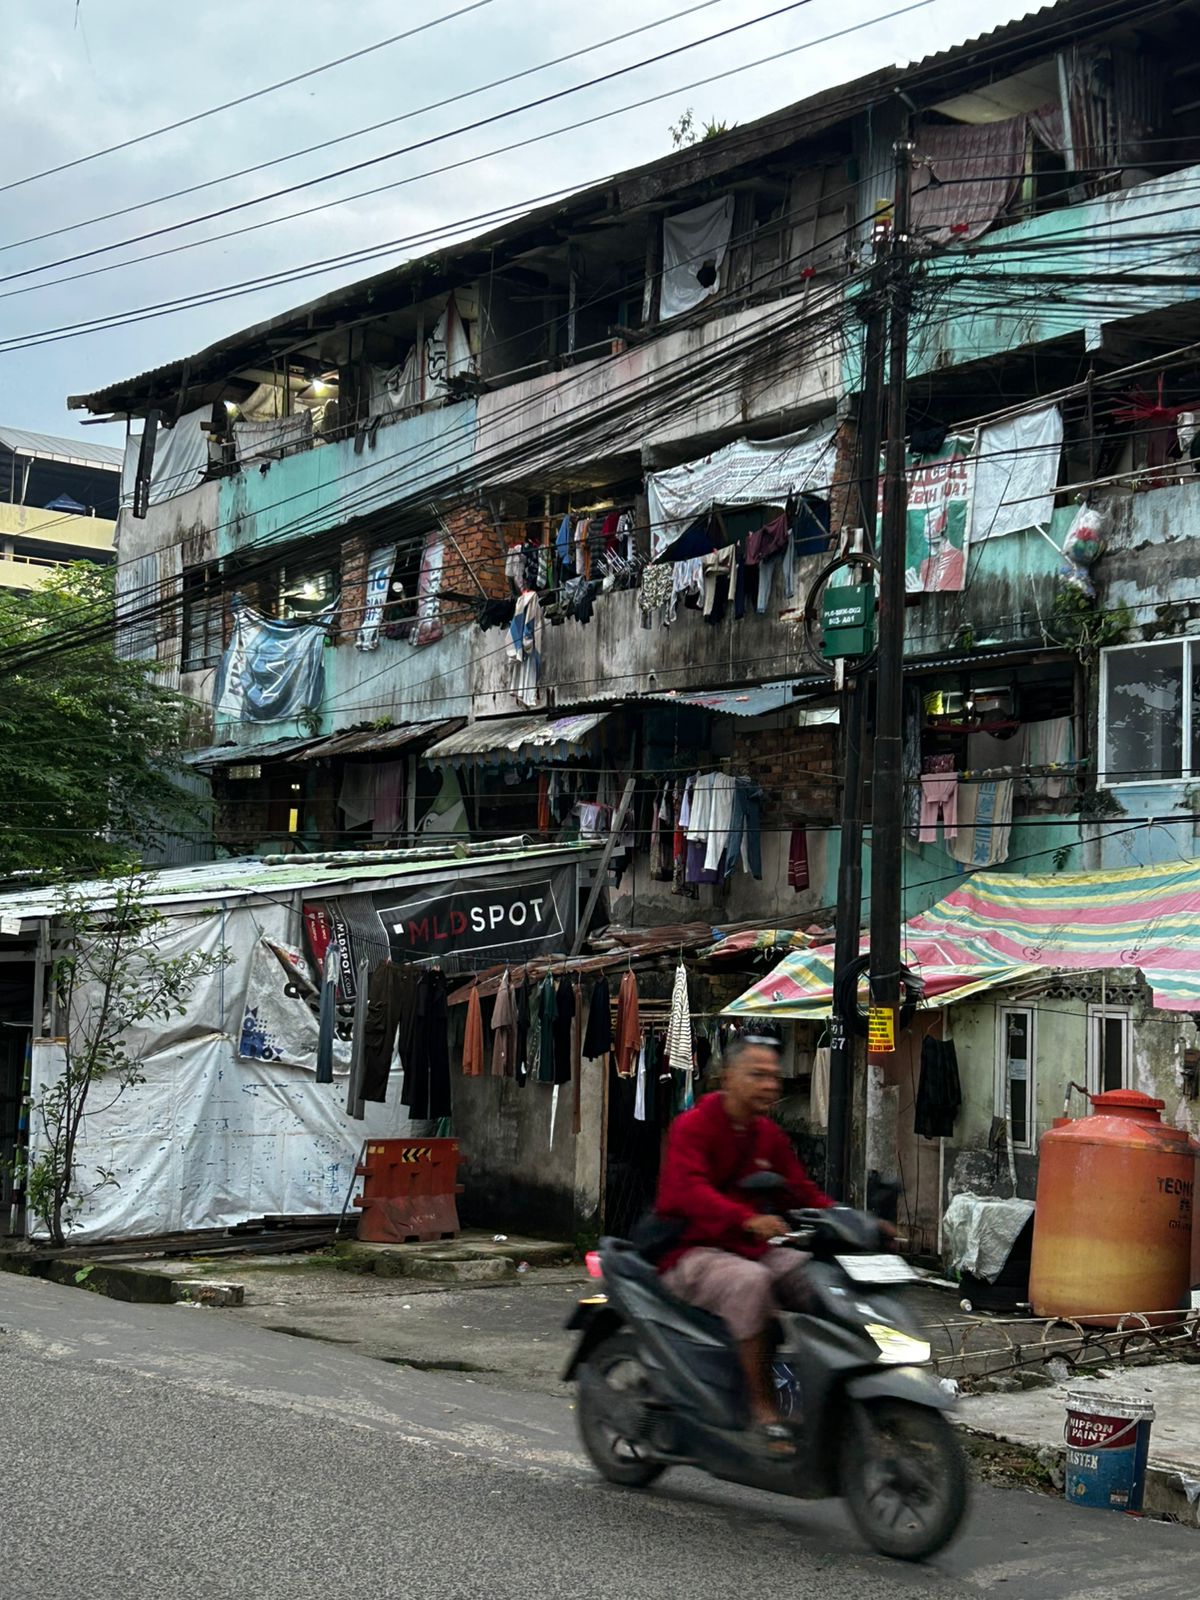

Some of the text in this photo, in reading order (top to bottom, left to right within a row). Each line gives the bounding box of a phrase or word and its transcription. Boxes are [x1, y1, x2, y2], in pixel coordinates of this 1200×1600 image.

[408, 898, 543, 945] MLDSPOT
[1069, 1418, 1114, 1434] NIPPON
[1071, 1427, 1107, 1442] PAINT
